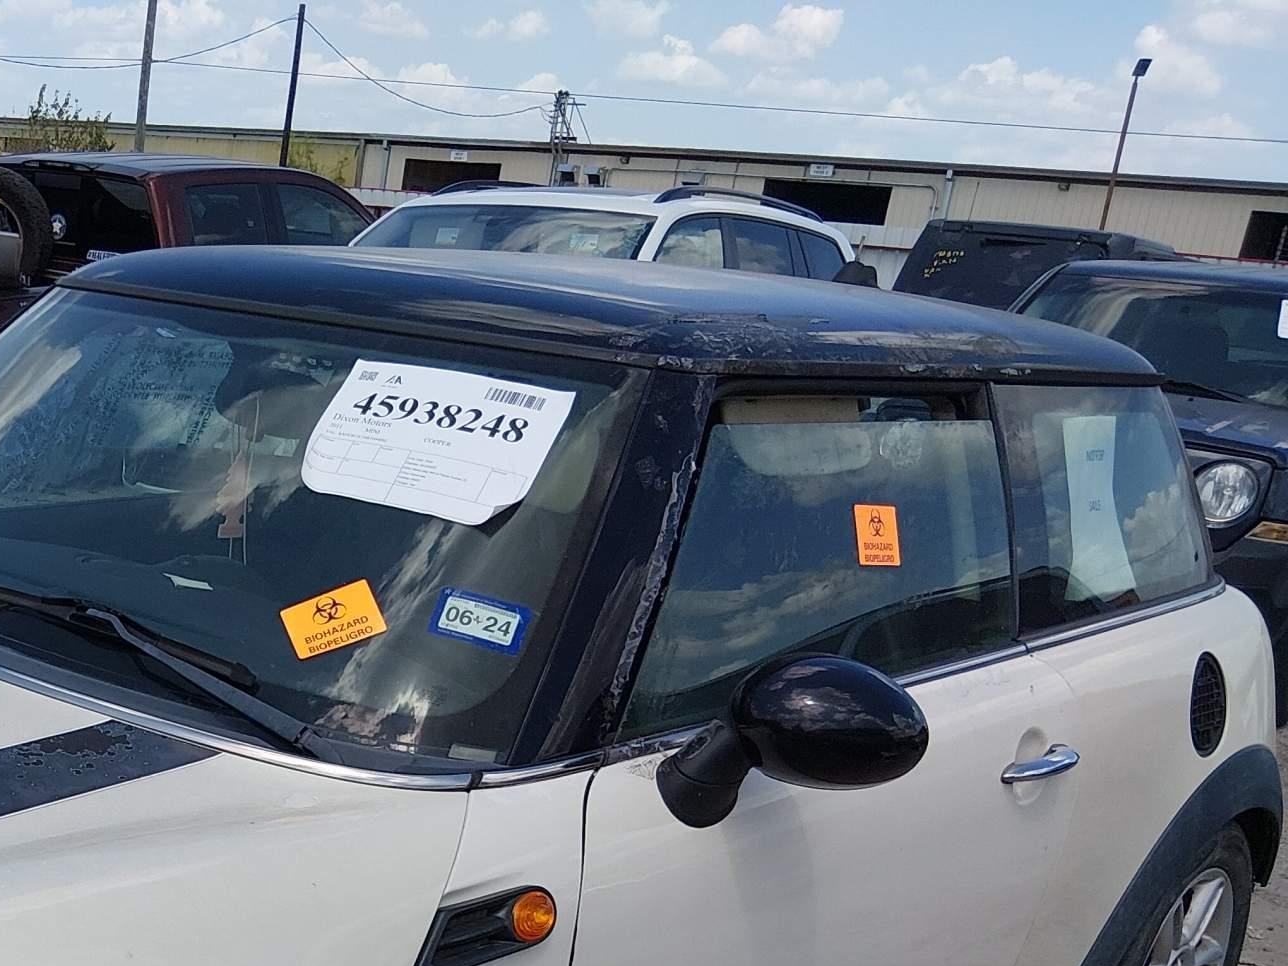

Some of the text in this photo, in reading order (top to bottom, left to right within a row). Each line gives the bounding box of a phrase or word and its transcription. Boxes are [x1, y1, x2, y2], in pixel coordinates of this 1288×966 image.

[333, 412, 393, 429] Dixon Motors
[352, 393, 530, 443] 45938248
[304, 615, 369, 645] BIOHAZARD
[308, 625, 374, 654] BIOPELIGRO
